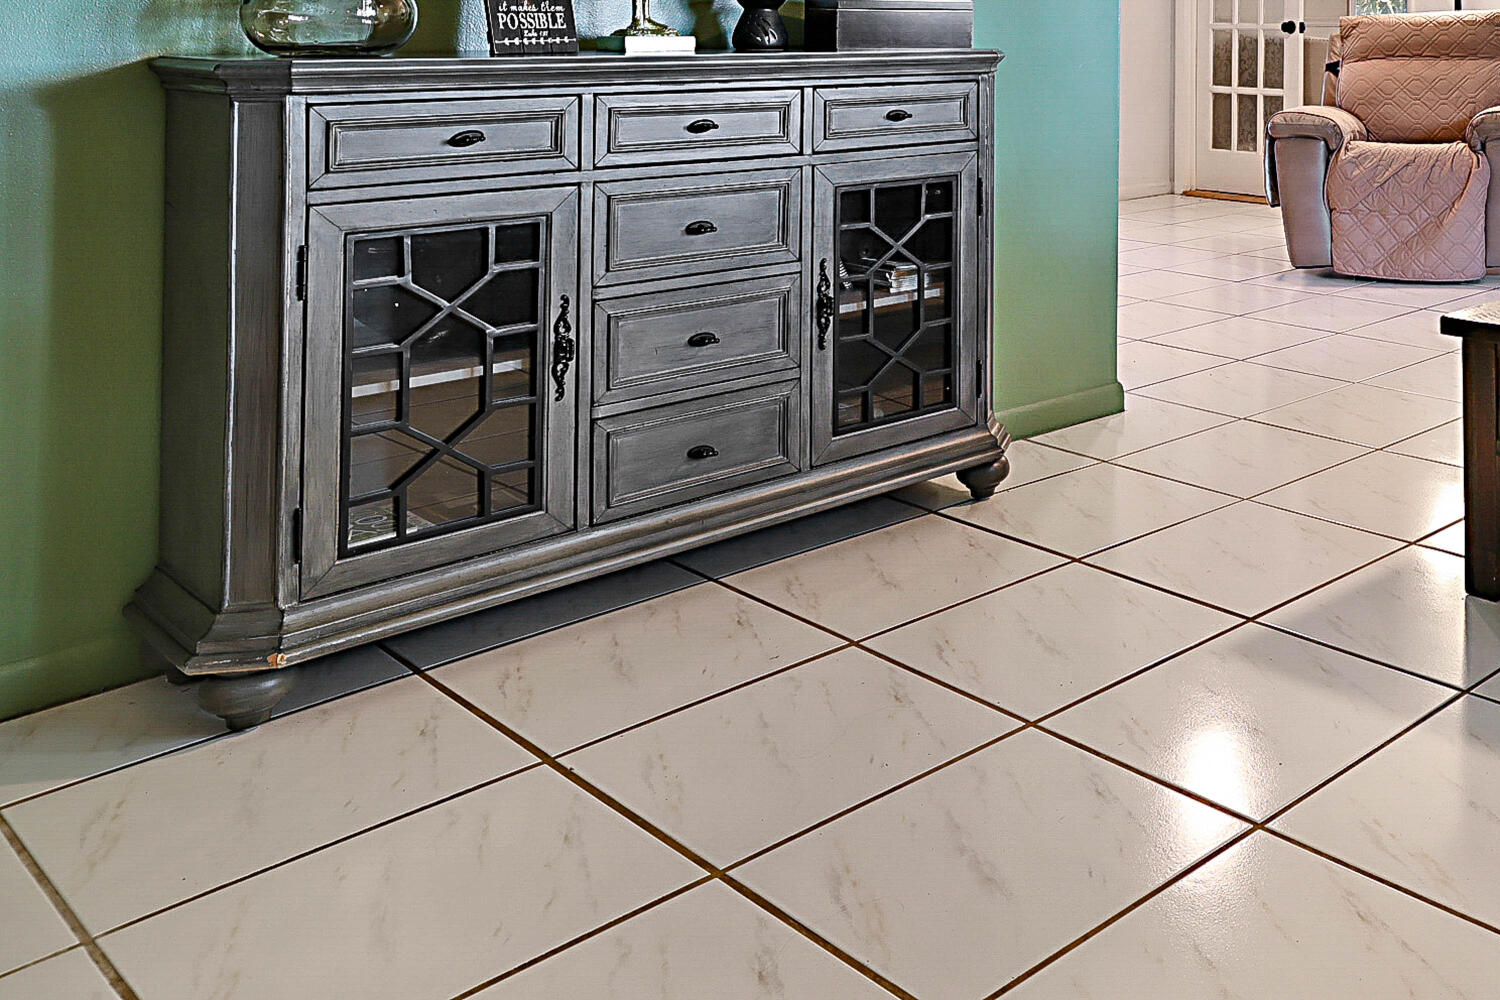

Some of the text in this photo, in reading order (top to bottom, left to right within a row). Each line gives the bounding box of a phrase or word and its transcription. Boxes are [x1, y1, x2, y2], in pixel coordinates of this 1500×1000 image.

[498, 0, 565, 12] it makes them
[497, 12, 567, 30] POSSIBLE
